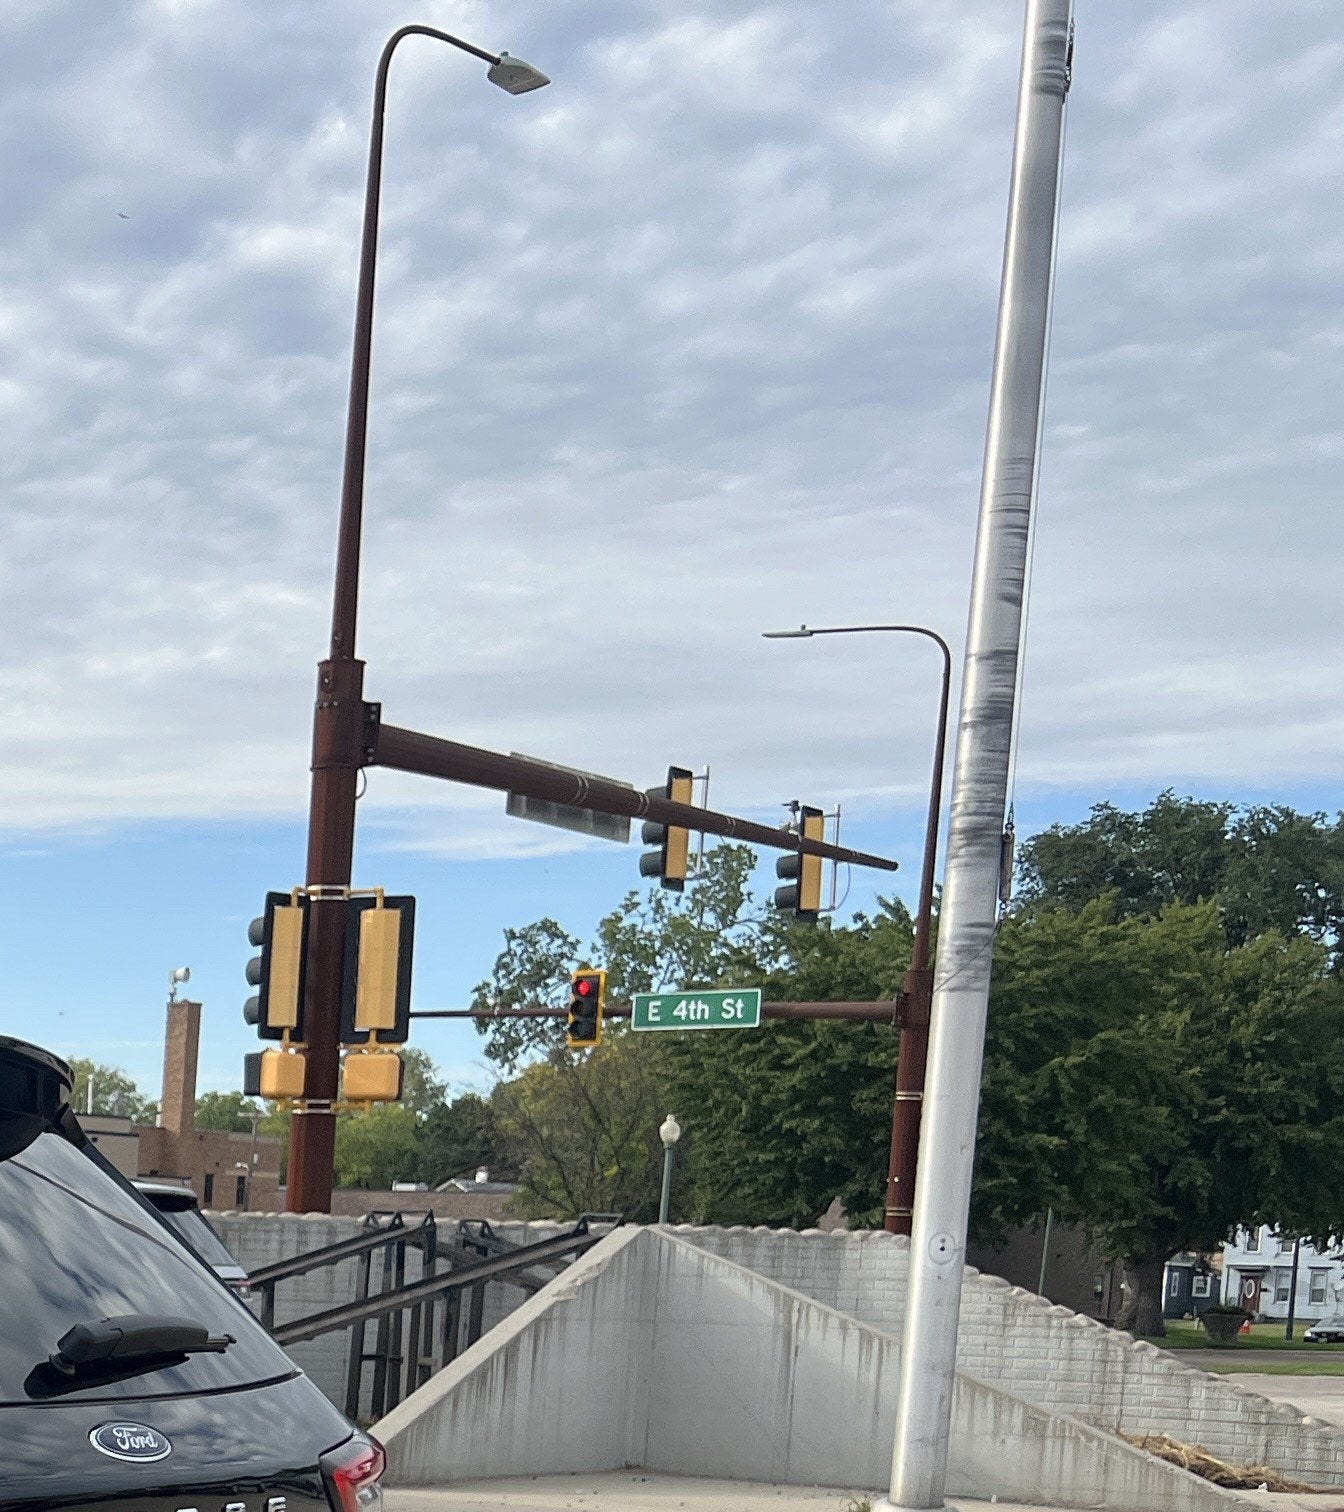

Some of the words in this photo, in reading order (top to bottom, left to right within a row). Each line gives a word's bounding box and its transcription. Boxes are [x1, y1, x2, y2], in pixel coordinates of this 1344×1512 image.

[648, 1000, 662, 1022] E
[672, 999, 710, 1021] 4th
[721, 997, 744, 1019] St
[112, 1426, 159, 1451] Ford
